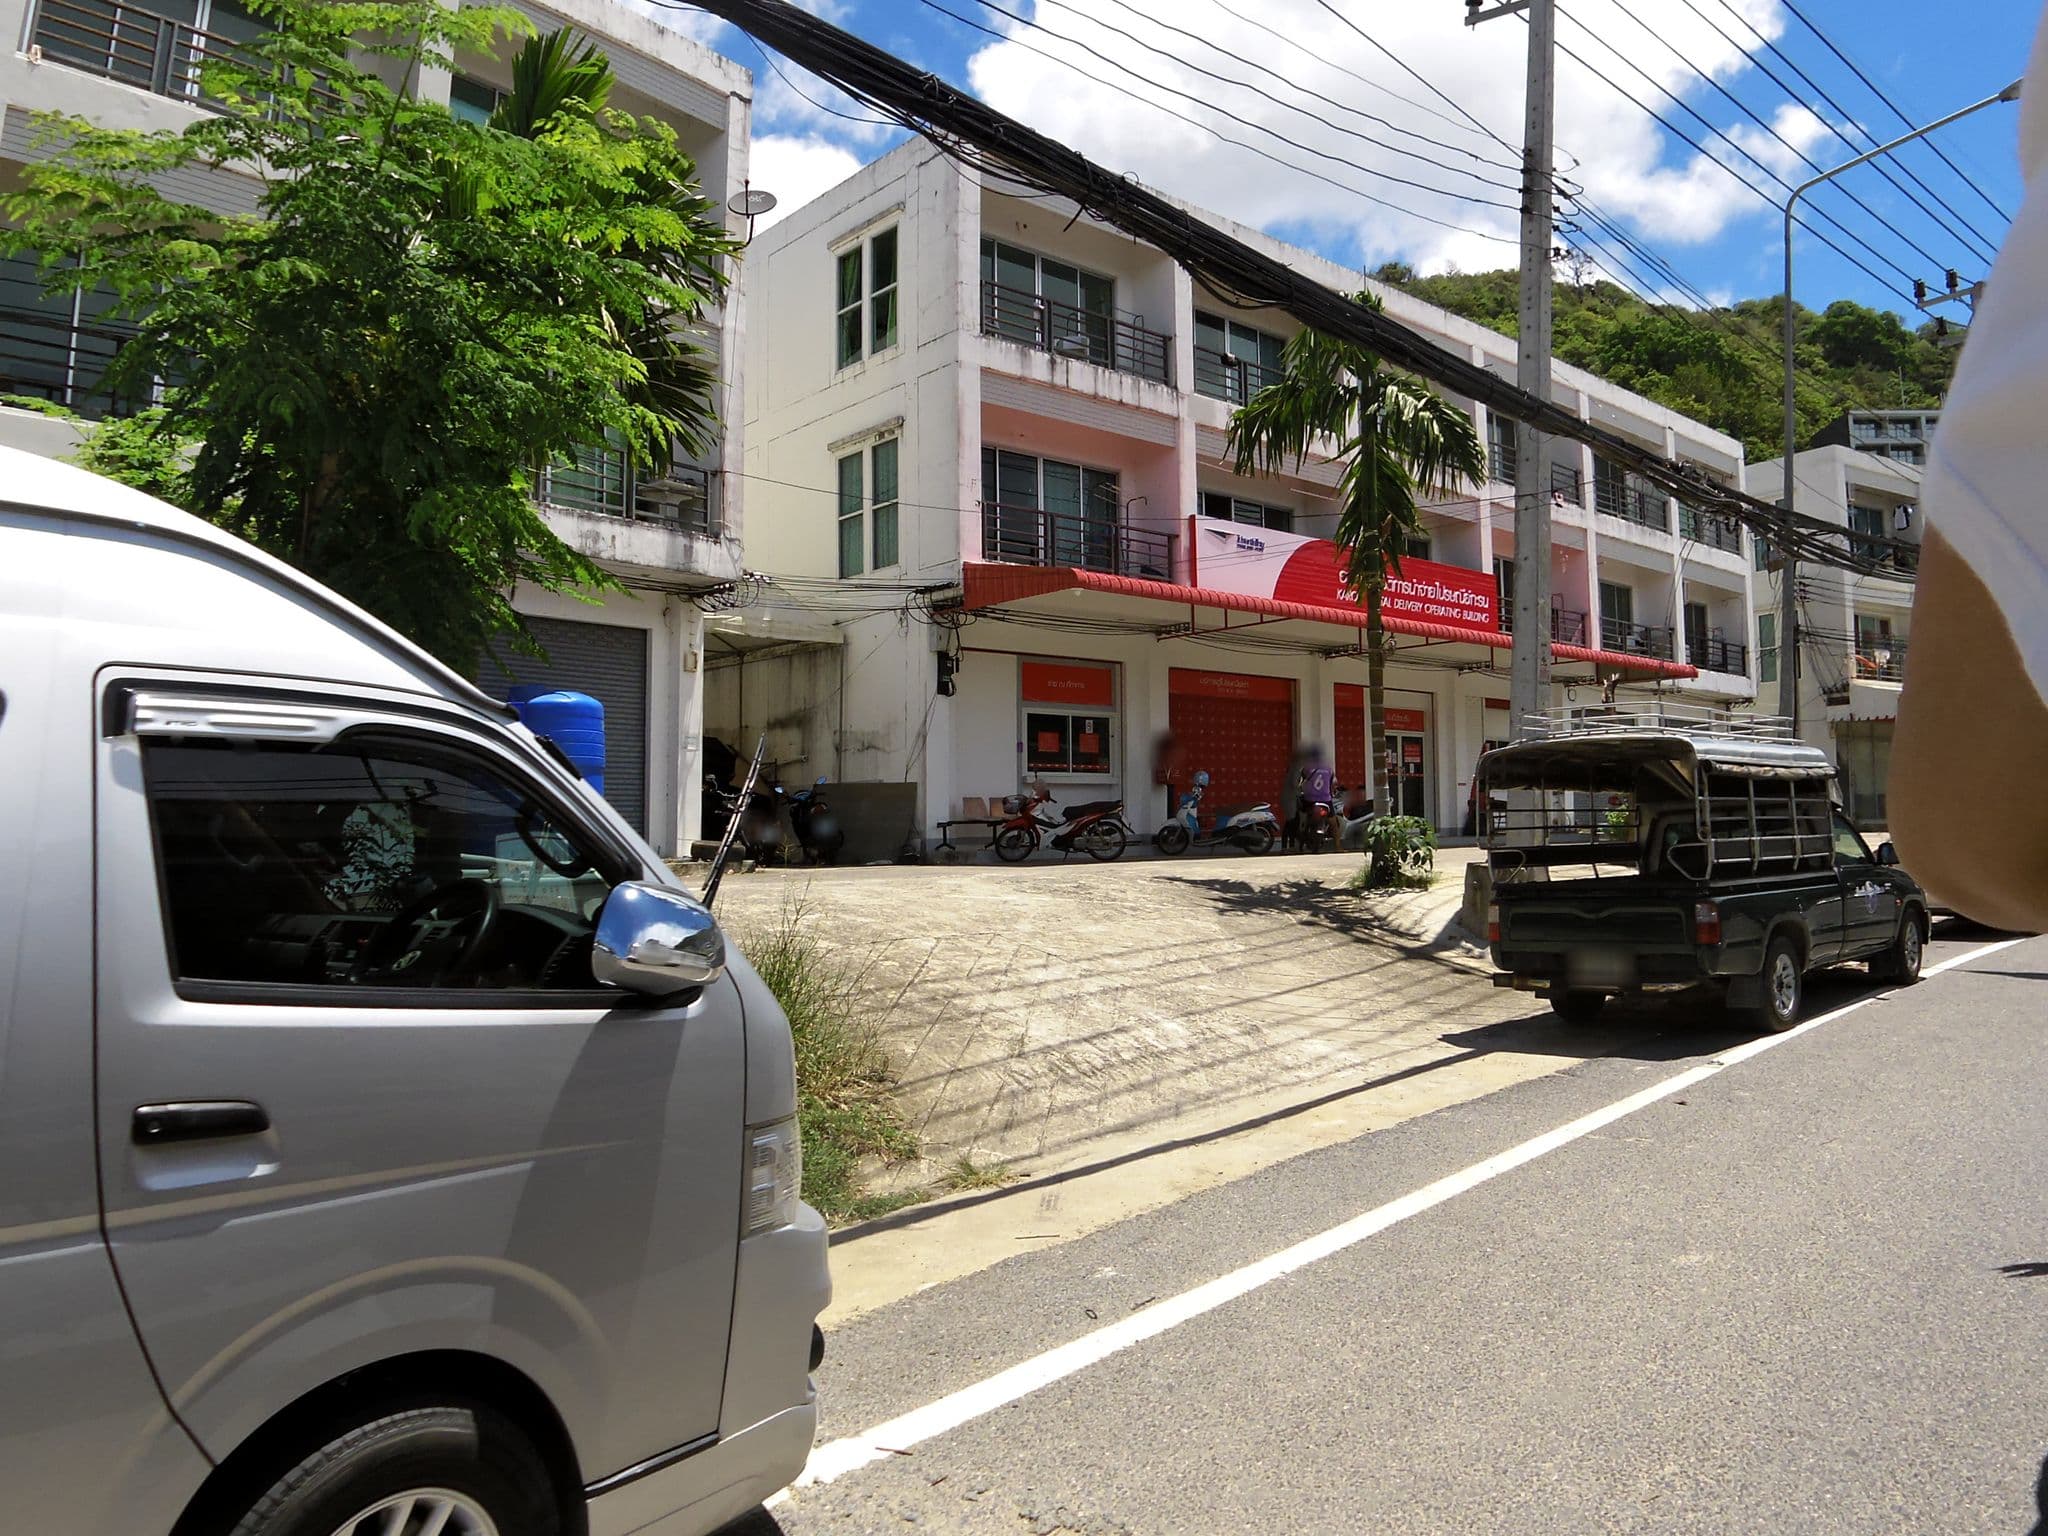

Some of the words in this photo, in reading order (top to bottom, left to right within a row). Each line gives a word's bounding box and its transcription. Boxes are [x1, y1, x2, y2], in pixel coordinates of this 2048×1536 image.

[1393, 598, 1423, 613] DELIVERY
[1424, 603, 1461, 620] OPERATING
[1462, 609, 1490, 624] BUILDING
[1314, 774, 1324, 791] 6
